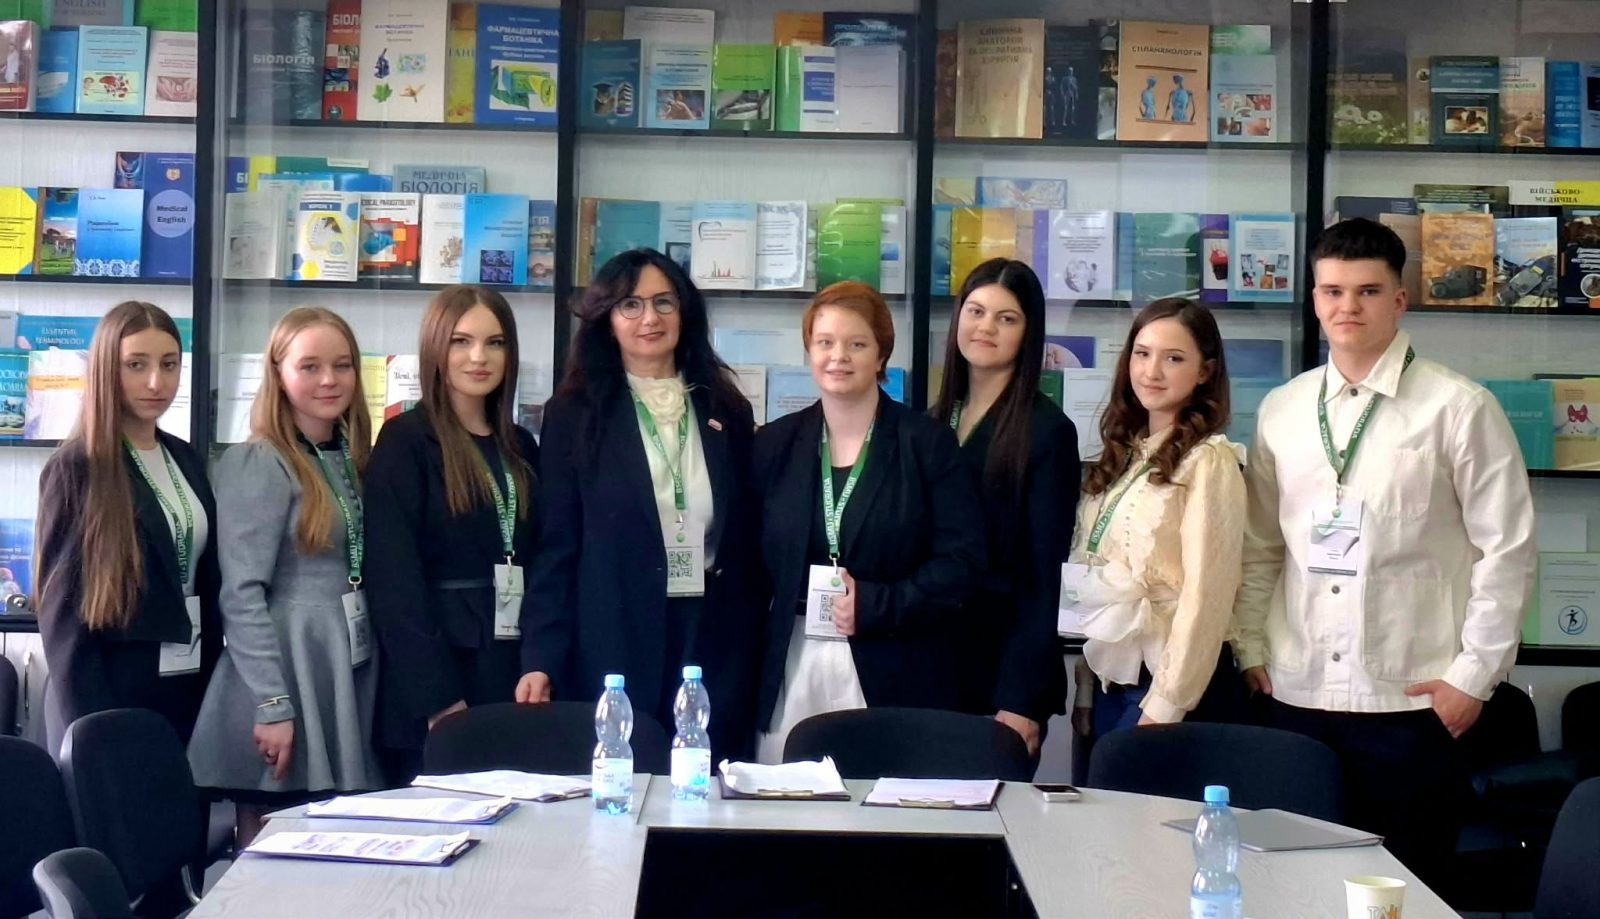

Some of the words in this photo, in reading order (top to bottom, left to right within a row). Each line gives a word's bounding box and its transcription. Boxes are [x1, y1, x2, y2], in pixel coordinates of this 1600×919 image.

[332, 14, 360, 26] БІОЛ
[486, 24, 560, 37] ФАРМАЦЕВТИЧНА
[502, 35, 544, 45] БОТАНІКА
[253, 53, 315, 65] БІОЛОГІЯ
[401, 181, 479, 194] БІОЛОГІЯ
[156, 216, 187, 224] English
[823, 477, 834, 517] STUDRADA
